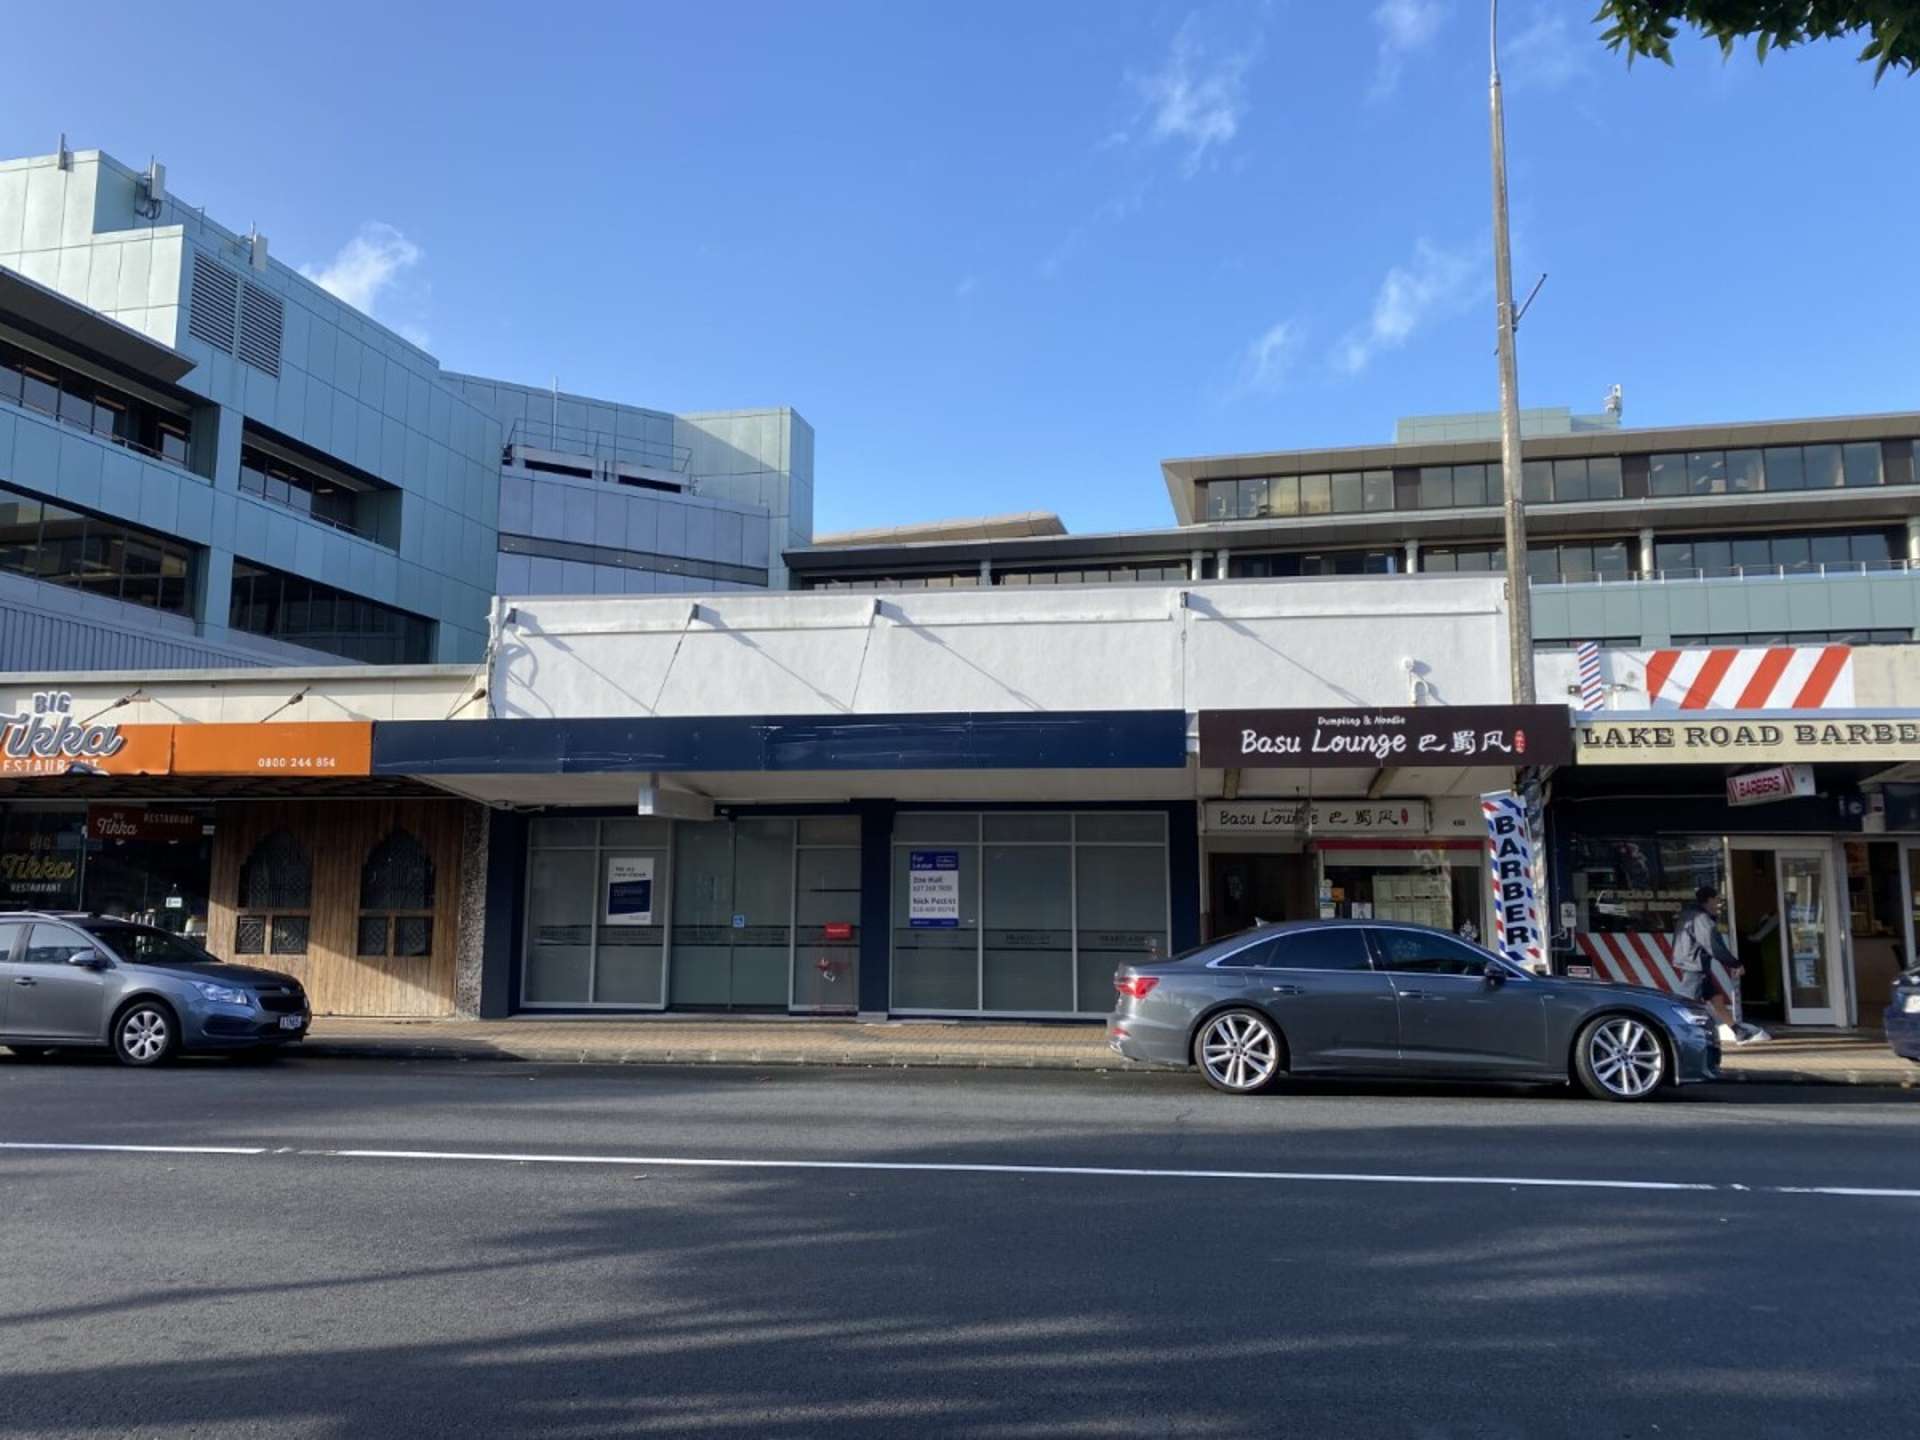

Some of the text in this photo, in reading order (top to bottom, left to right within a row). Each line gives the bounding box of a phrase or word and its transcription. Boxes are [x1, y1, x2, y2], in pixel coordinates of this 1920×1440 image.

[32, 690, 73, 714] BIG
[1317, 715, 1361, 728] Dumpling
[1374, 715, 1406, 726] Noodle
[0, 712, 124, 758] Tikka
[1240, 728, 1407, 759] Basu Lounge
[1582, 726, 1675, 749] LAKE
[1684, 725, 1784, 748] ROAD
[258, 757, 286, 768] 0800
[1738, 774, 1781, 797] BARBERS
[96, 817, 138, 836] Tikka
[1220, 810, 1255, 825] Basu
[1494, 814, 1530, 946] BARBER
